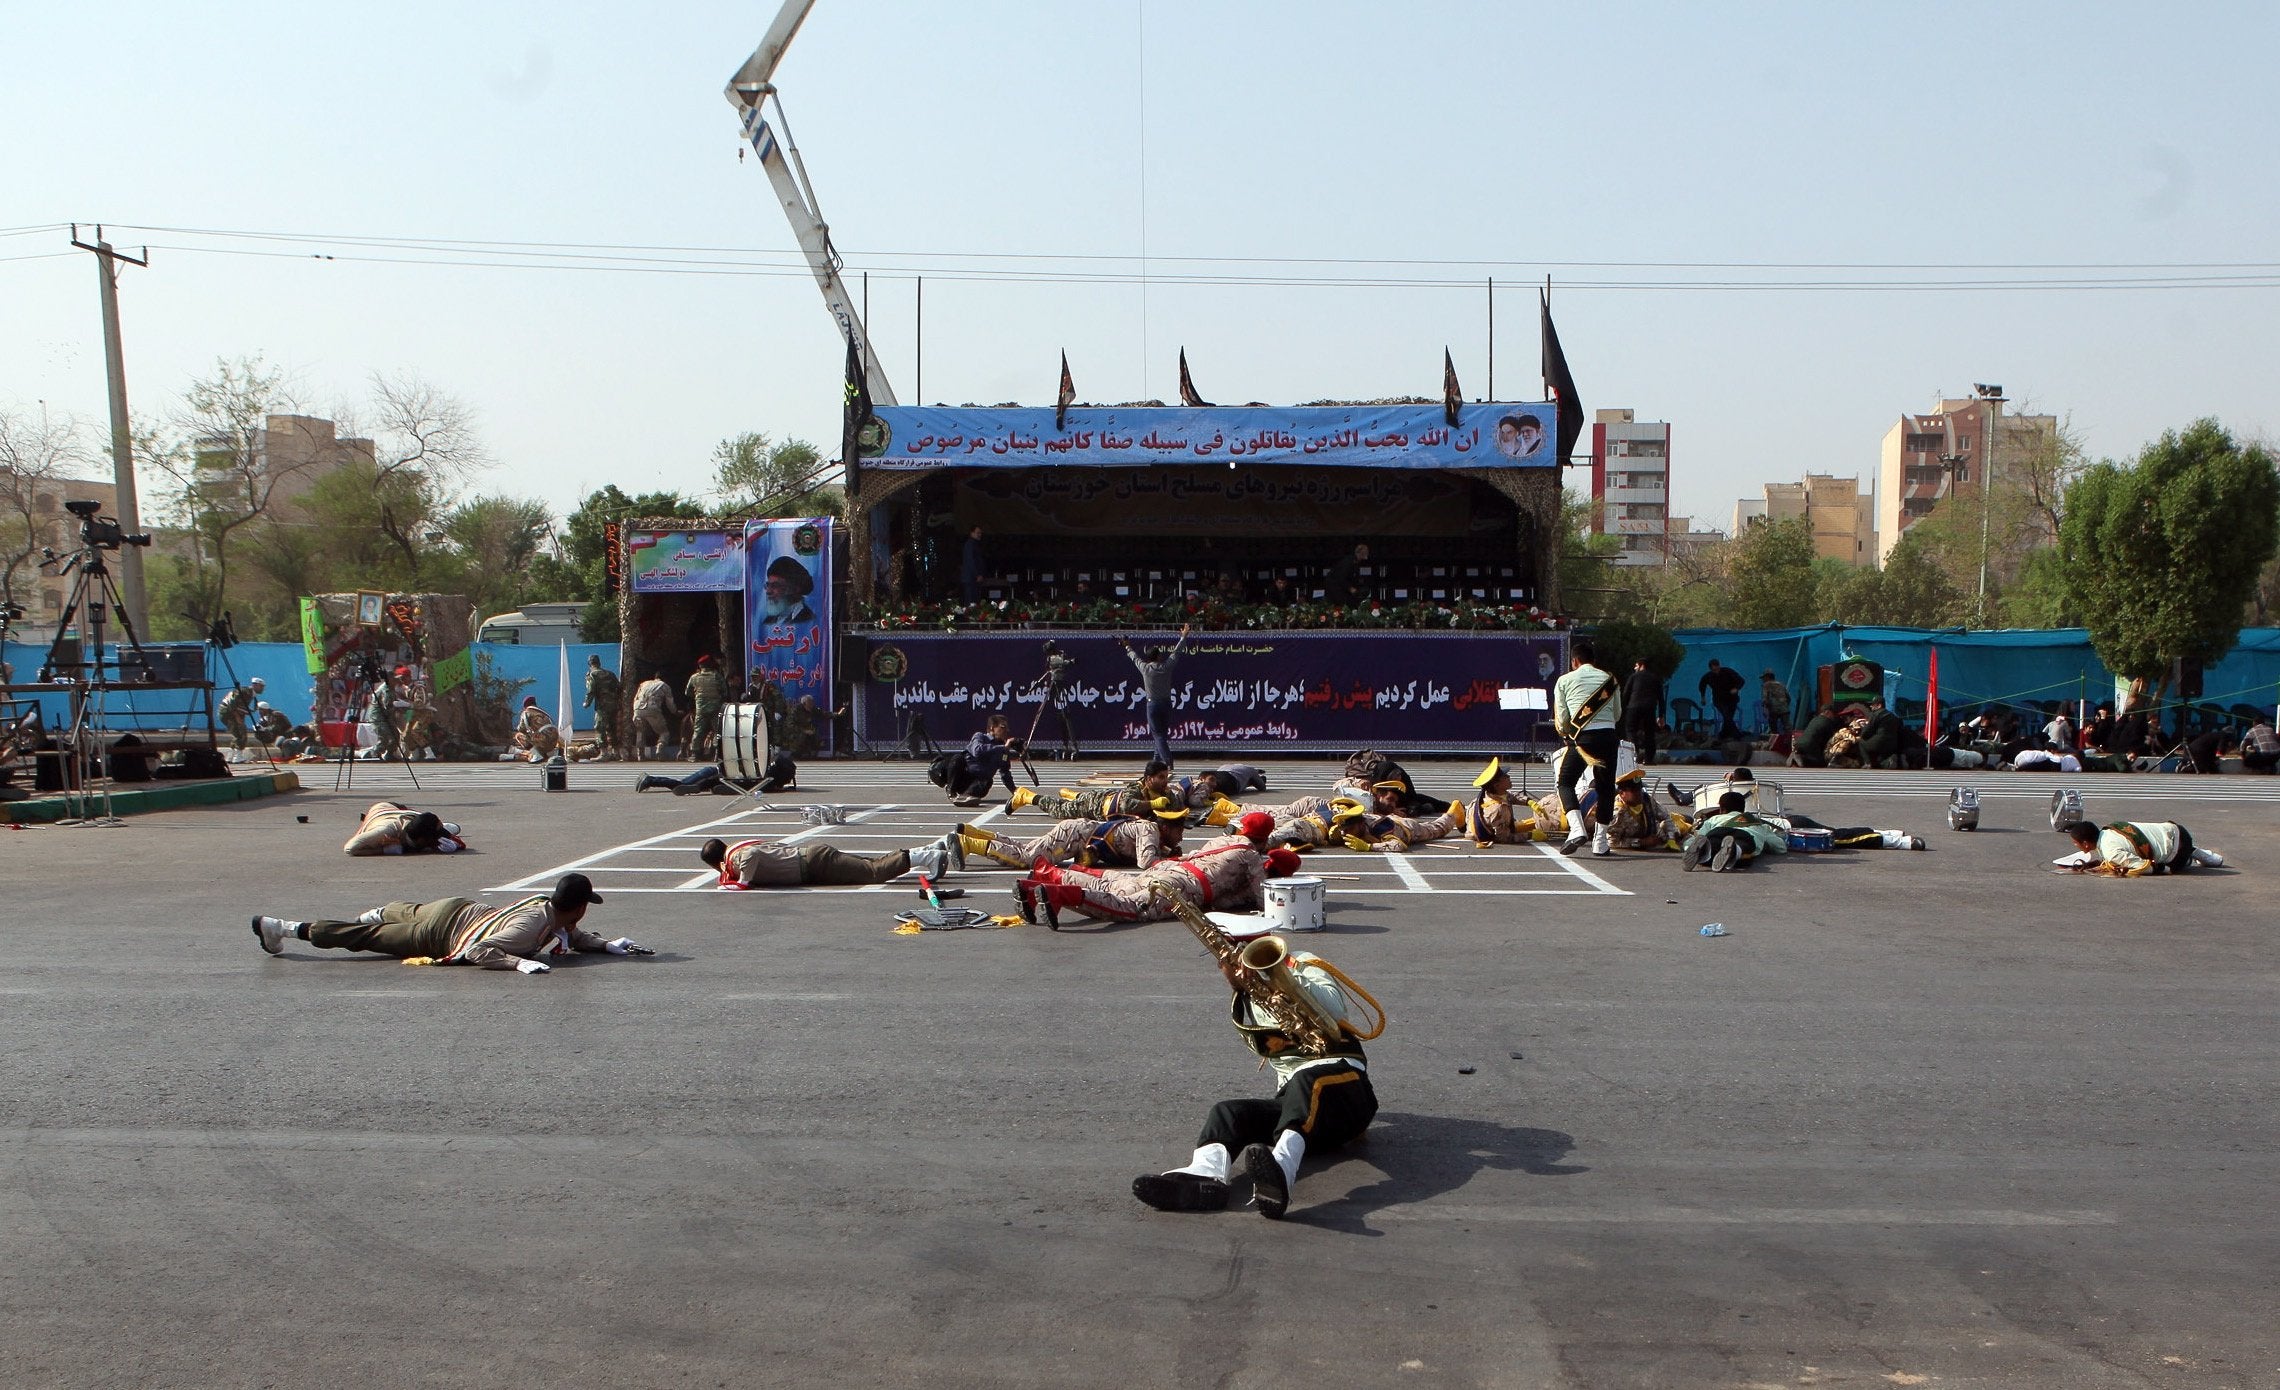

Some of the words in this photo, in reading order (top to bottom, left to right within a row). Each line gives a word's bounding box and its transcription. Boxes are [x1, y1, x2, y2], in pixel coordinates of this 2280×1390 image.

[915, 459, 932, 467] عمومی
[1026, 474, 1110, 500] خوزستان
[1115, 473, 1167, 499] استان
[1172, 474, 1222, 499] مسلح
[1226, 473, 1304, 501] نیروهای
[752, 625, 821, 653] ارتش
[1225, 645, 1245, 655] امام
[1246, 645, 1274, 655] حضرت
[781, 659, 805, 688] چشم
[893, 681, 935, 709] ماندیم
[939, 682, 968, 709] عقب
[972, 681, 1012, 710] کردیم
[1197, 679, 1244, 709] انقلابی
[1246, 680, 1261, 709] از
[1343, 680, 1374, 710] پیش
[1376, 680, 1416, 710] کردیم
[1420, 680, 1450, 709] عمل
[1122, 722, 1150, 739] اهواز
[1226, 725, 1263, 739] عمومی
[1266, 722, 1298, 739] روابط
